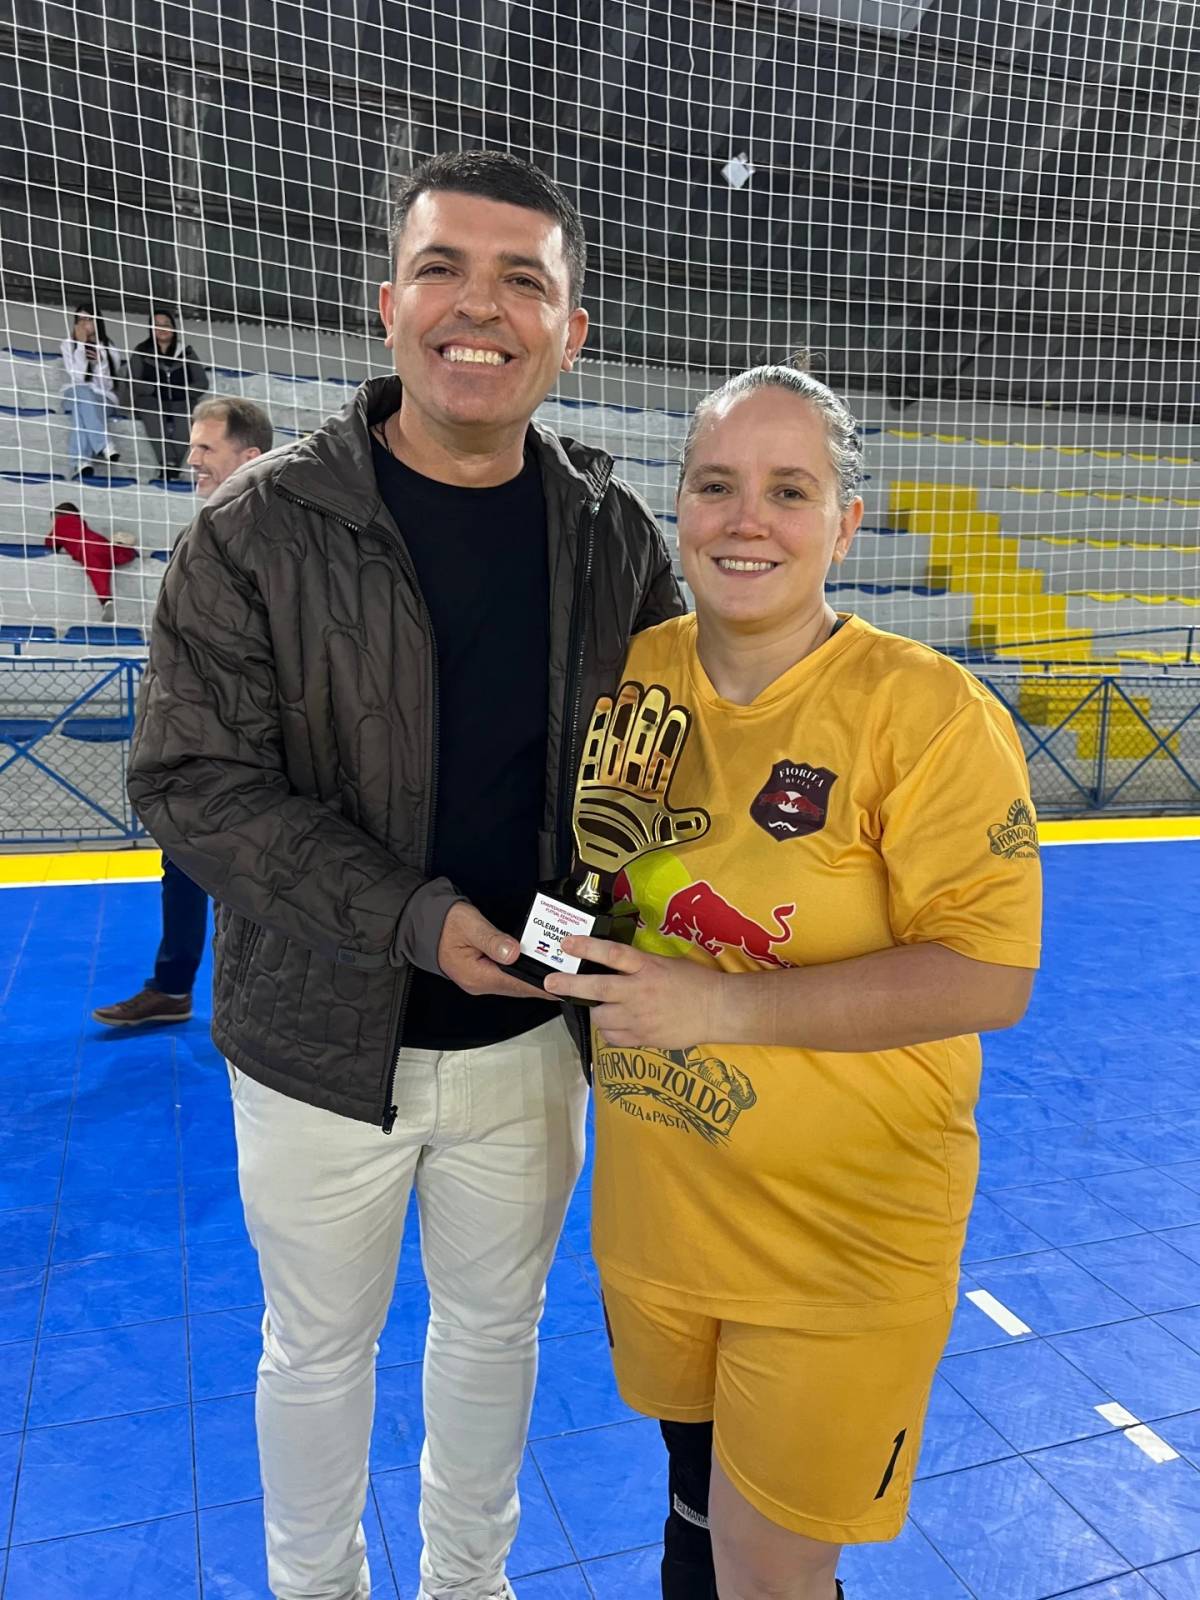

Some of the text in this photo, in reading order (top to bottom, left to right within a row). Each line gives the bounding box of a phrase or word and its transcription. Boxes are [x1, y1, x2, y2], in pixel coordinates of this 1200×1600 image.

[779, 767, 824, 788] FIORITA
[996, 826, 1023, 848] FORNO
[533, 917, 559, 932] GOLEIRA
[600, 1051, 732, 1124] FORNO DI ZOLDO
[619, 1097, 691, 1134] PIZZA & PASTA
[872, 1426, 903, 1501] 1
